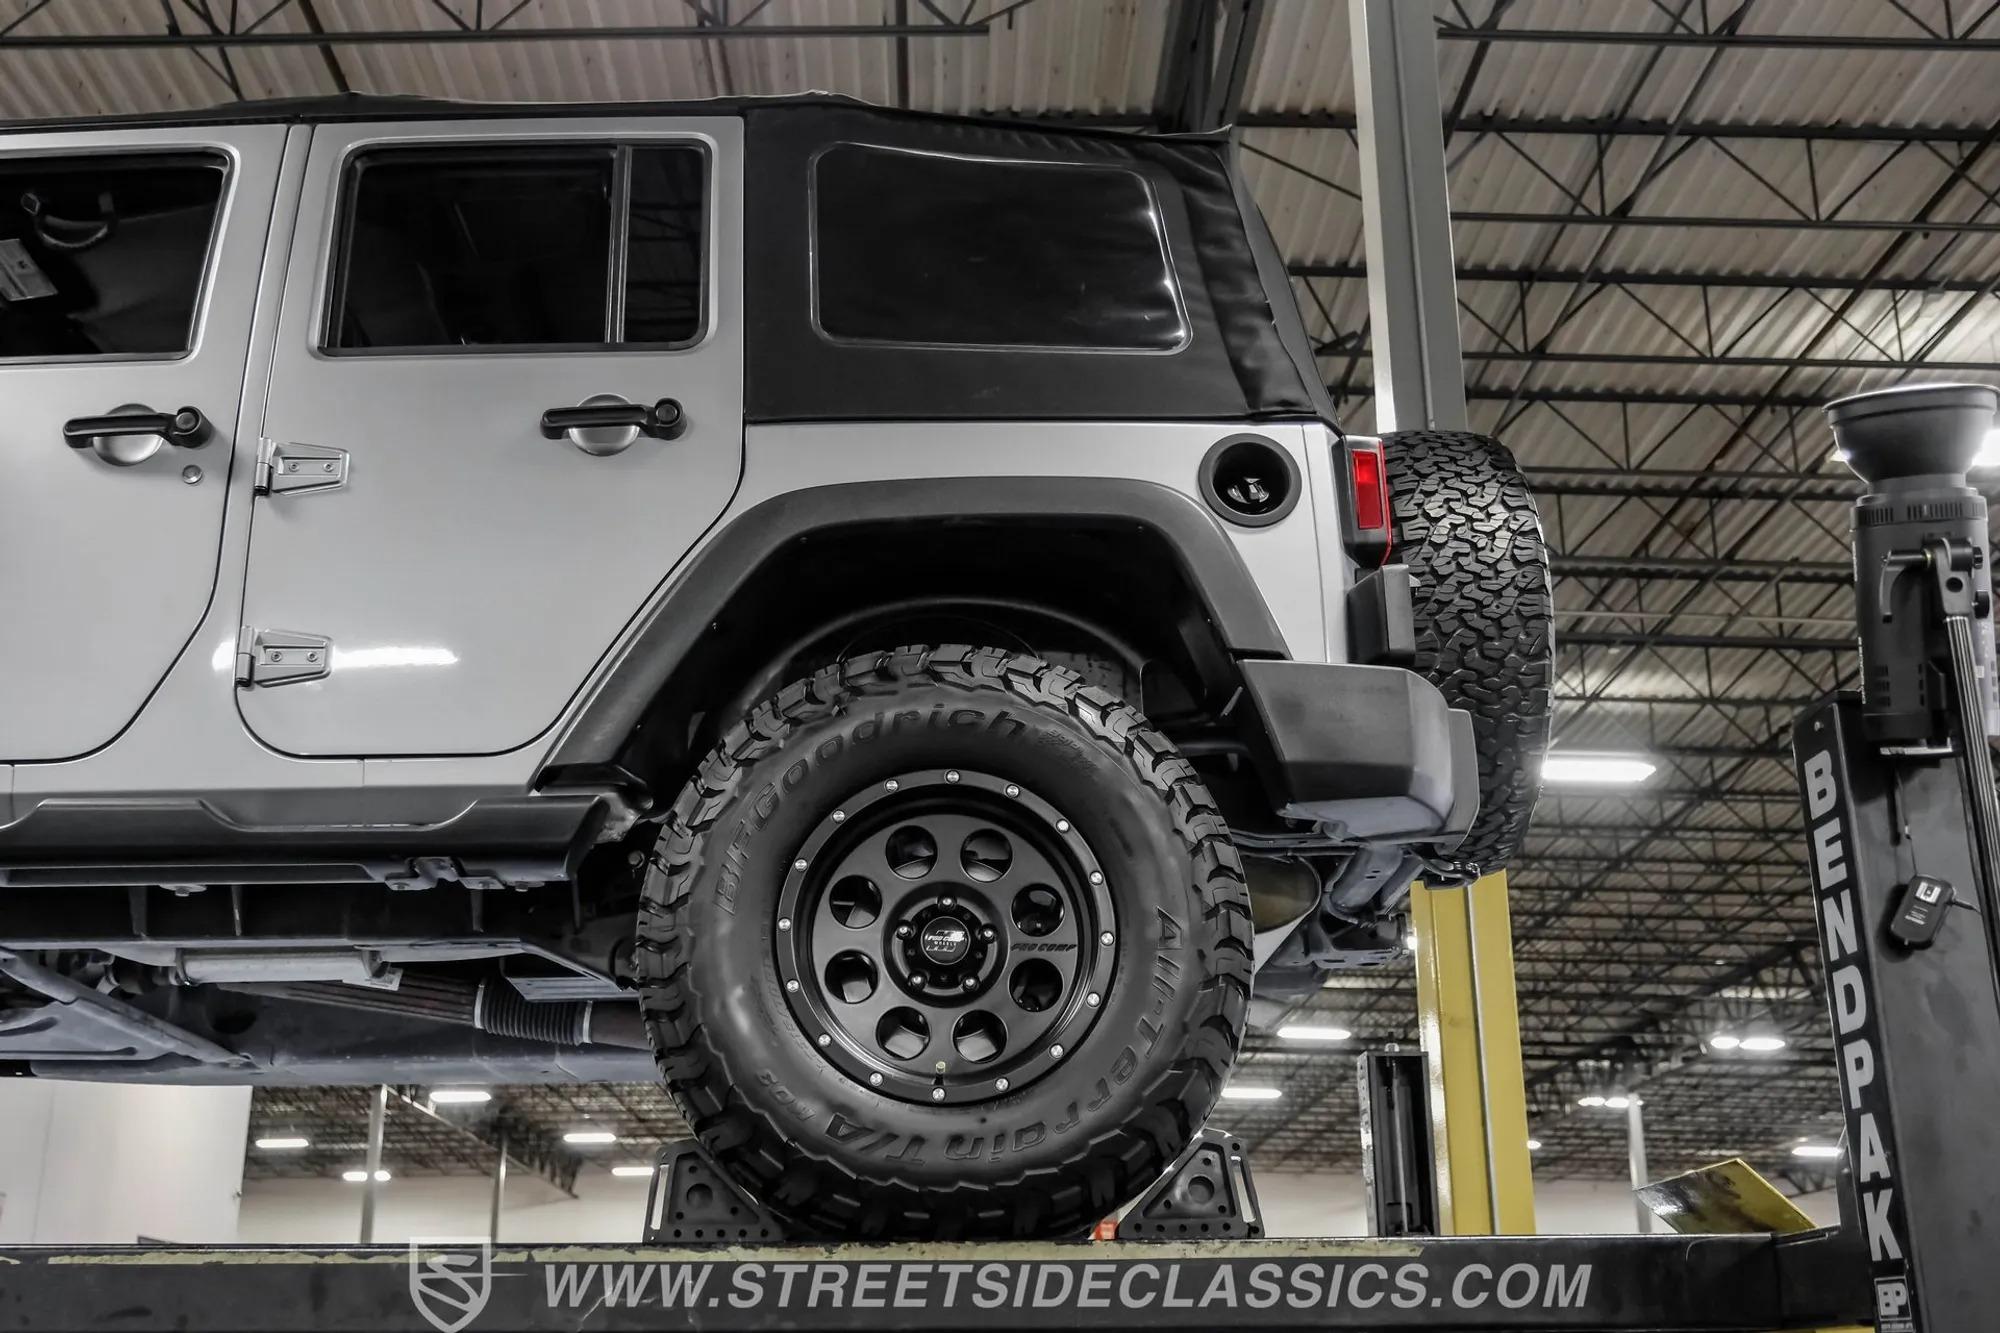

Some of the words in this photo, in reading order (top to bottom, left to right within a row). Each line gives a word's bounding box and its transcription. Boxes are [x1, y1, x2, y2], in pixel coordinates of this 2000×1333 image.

[713, 703, 1027, 916] BFGoodrich
[943, 905, 1184, 1163] All-Terrain
[1804, 749, 1904, 1262] BENDPAK
